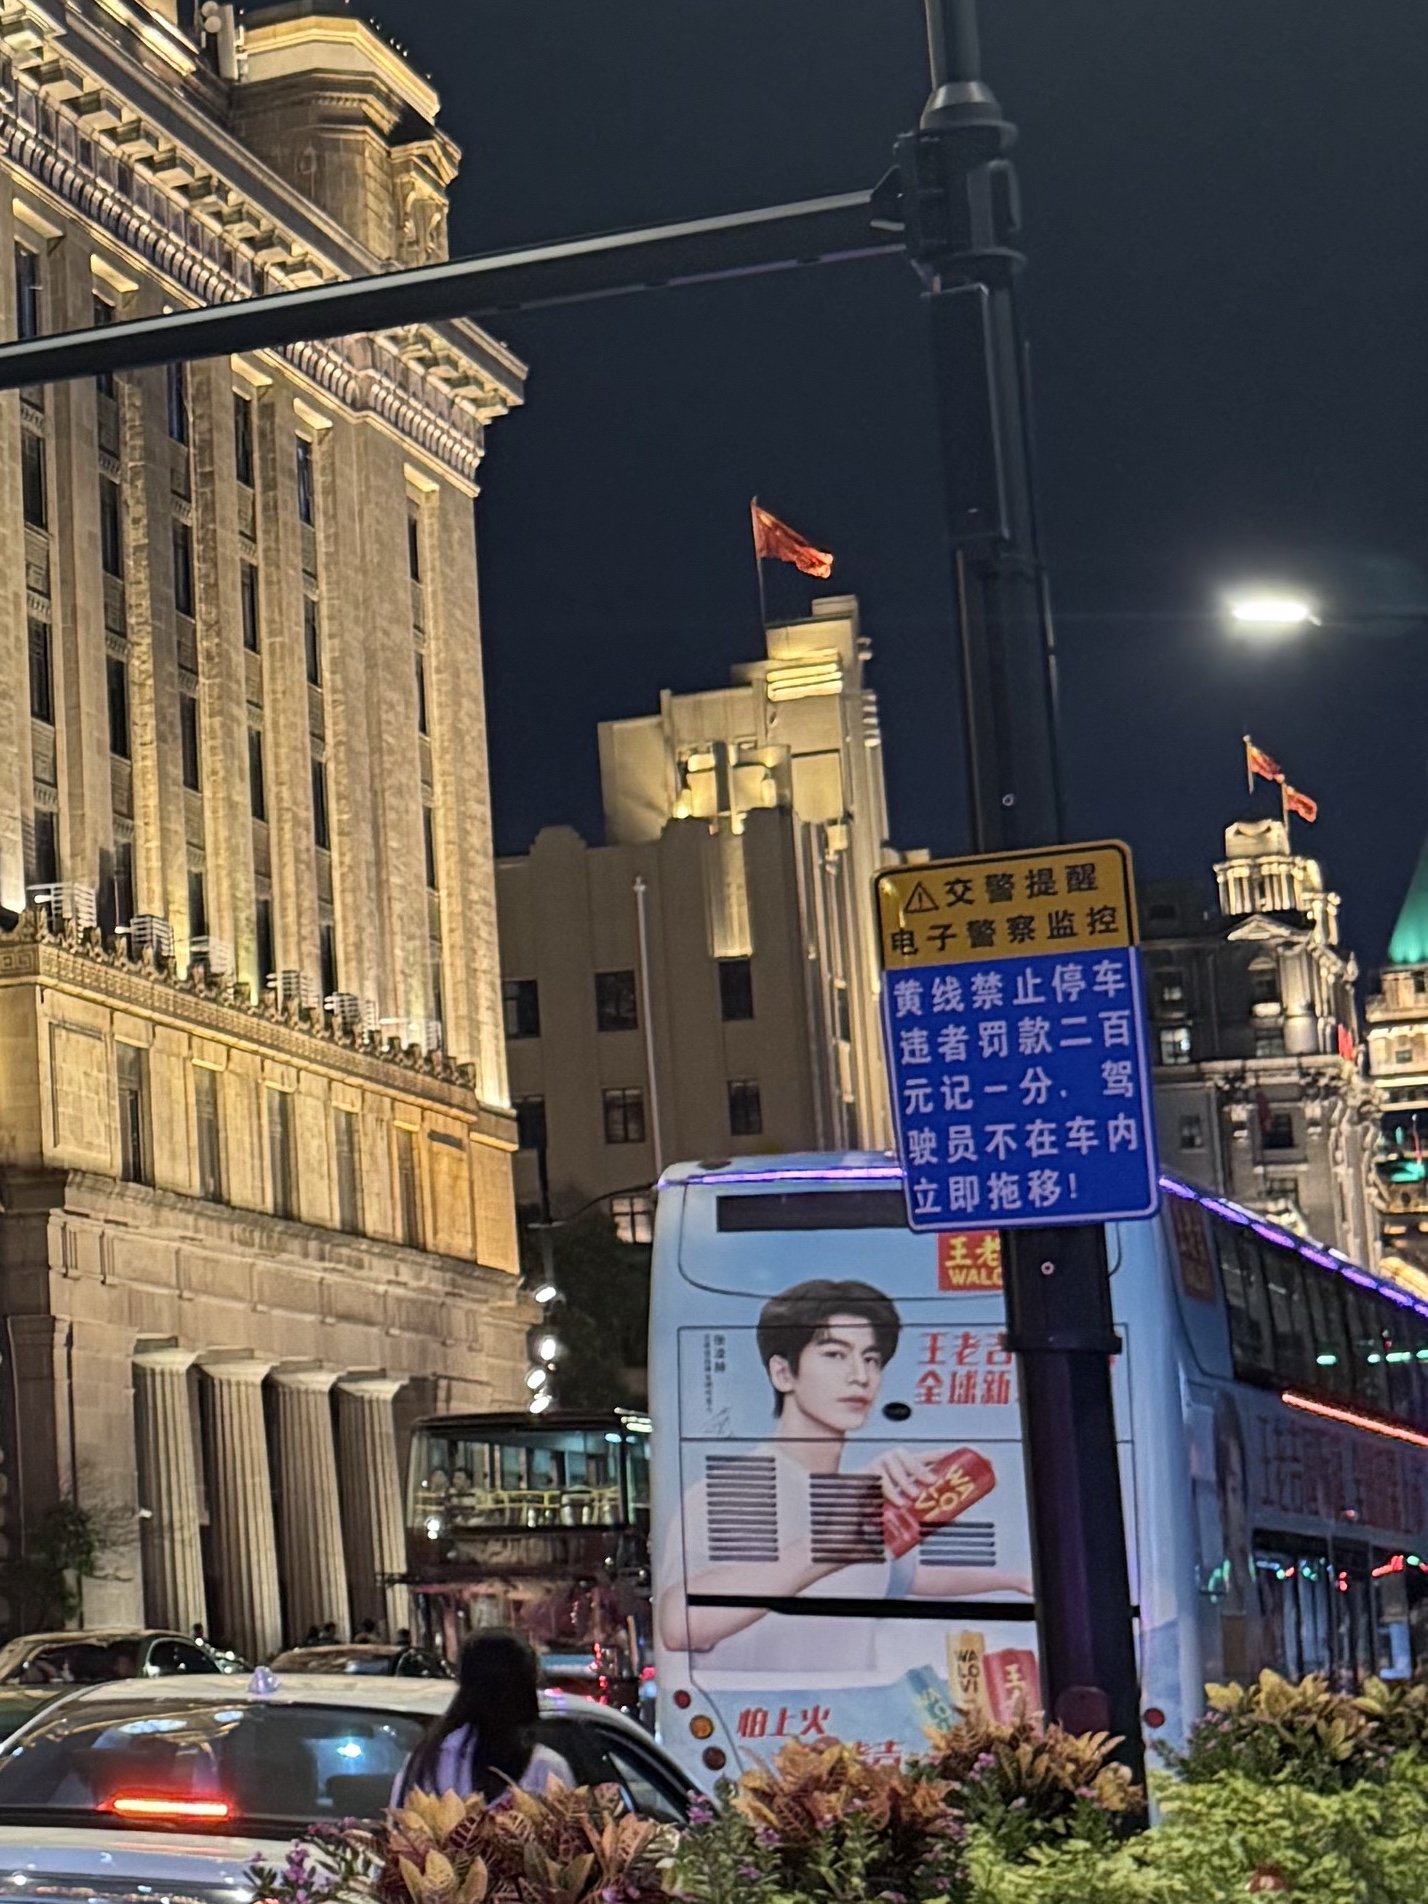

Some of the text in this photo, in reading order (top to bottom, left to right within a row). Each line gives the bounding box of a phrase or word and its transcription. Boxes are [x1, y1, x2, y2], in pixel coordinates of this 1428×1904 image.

[943, 862, 1099, 907] 交警提醒
[890, 904, 1120, 956] 电子警察监控
[893, 959, 1127, 1018] 黄线禁止停车
[899, 1009, 1131, 1065] 违者罚款二百
[907, 1111, 1139, 1166] 驶员不在车内
[737, 1705, 832, 1738] 怕上火
